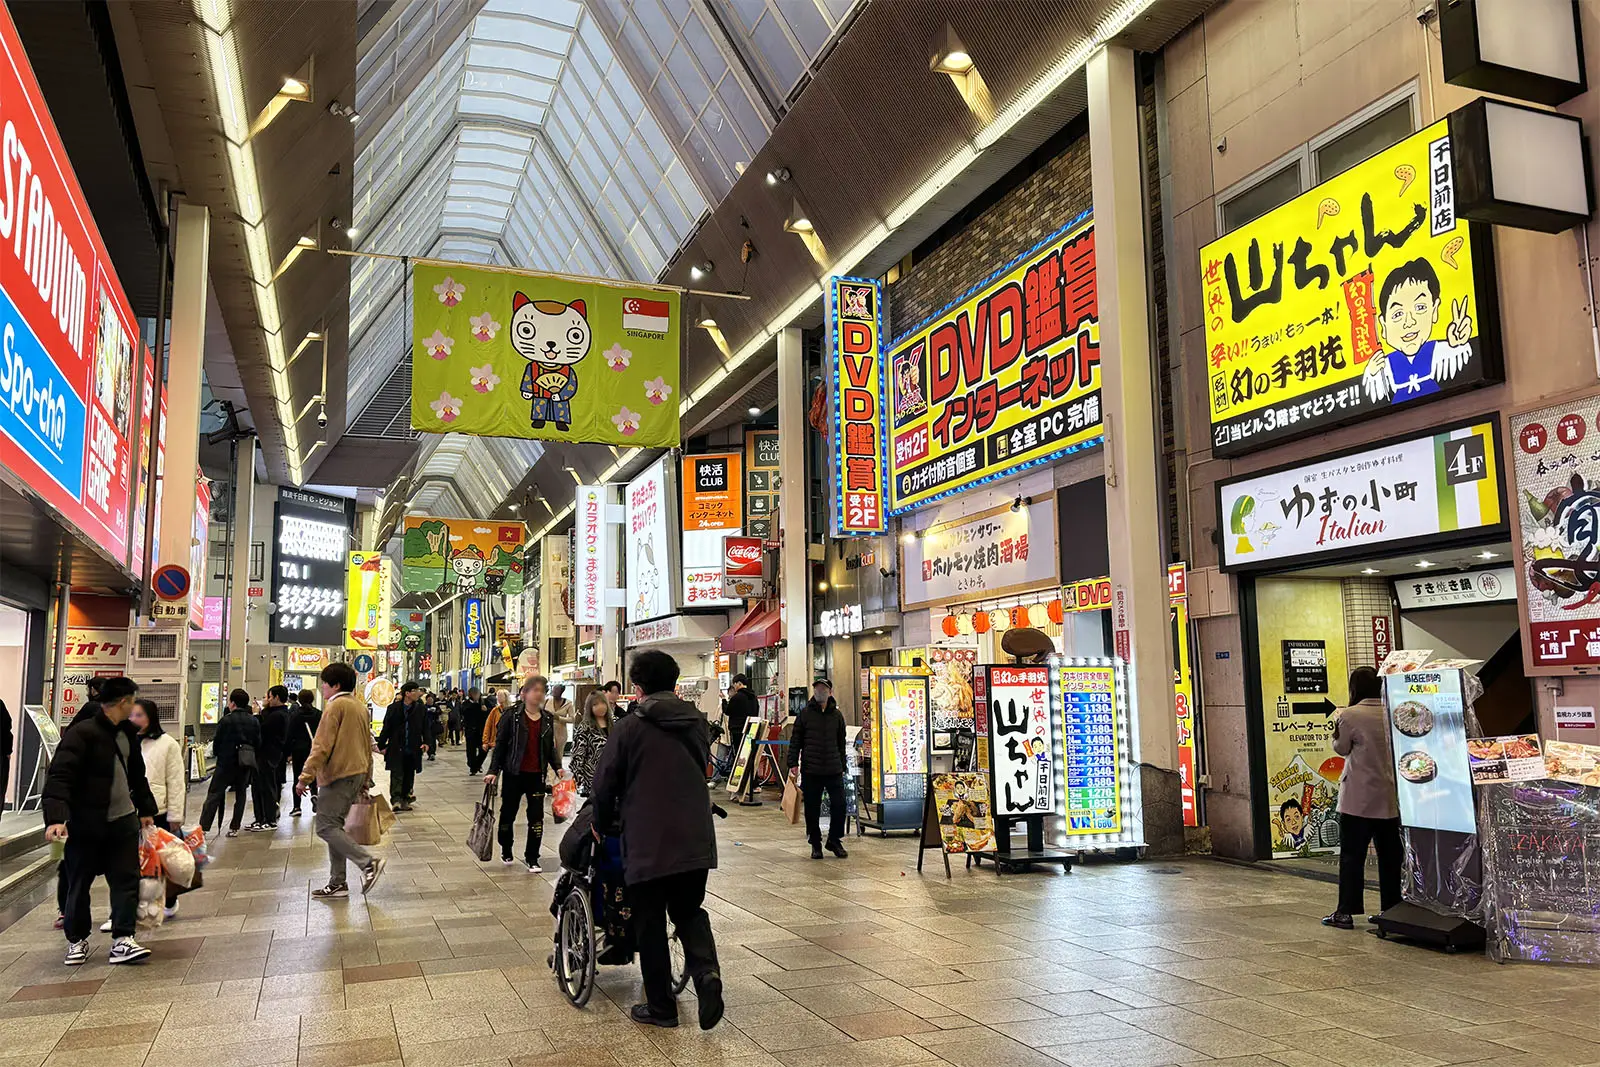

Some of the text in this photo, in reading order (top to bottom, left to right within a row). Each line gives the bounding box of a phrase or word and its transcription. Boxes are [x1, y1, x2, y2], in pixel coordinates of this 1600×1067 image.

[1433, 141, 1452, 230] 千日前店
[0, 119, 87, 361] STADIUM
[1224, 192, 1427, 323] 山ちゃん
[1203, 259, 1225, 332] 世界の
[627, 331, 665, 341] SINGAPORE
[930, 234, 1098, 407] DVD鑑賞
[1349, 281, 1373, 358] 幻の手羽先
[1231, 336, 1347, 405] 幻の手羽先
[841, 320, 877, 491] DVD鑑賞
[931, 331, 1101, 449] インターネット
[1214, 378, 1227, 408] 名物
[1010, 395, 1099, 455] 全室 PC 完備
[1231, 384, 1361, 441] 当ビル3階までどうぞ!!
[91, 403, 117, 476] CRANE
[759, 440, 779, 451] 快活
[895, 428, 928, 464] 受付2F
[1527, 435, 1540, 449] 肉
[1566, 425, 1578, 440] 魚
[699, 463, 723, 476] 快活
[911, 448, 977, 491] カギ付防音個室
[1447, 443, 1484, 478] 4F
[87, 451, 110, 514] GAME
[700, 477, 723, 486] CLUB
[689, 511, 734, 519] インターネット
[698, 502, 723, 510] コミック
[849, 494, 875, 506] 受付
[850, 508, 875, 526] 2F
[1280, 478, 1418, 530] ゆずの小町
[586, 502, 598, 545] カラオケ
[1315, 511, 1388, 546] Italian
[687, 587, 722, 602] まねき
[1078, 581, 1112, 607] DVD
[1412, 578, 1473, 596] すき焼き鍋
[154, 605, 187, 615] 自動車
[53, 642, 123, 656] ラオケ
[1540, 630, 1560, 641] 地下
[1273, 720, 1335, 733] エレベーターで3
[993, 698, 1035, 812] 山ちゃん
